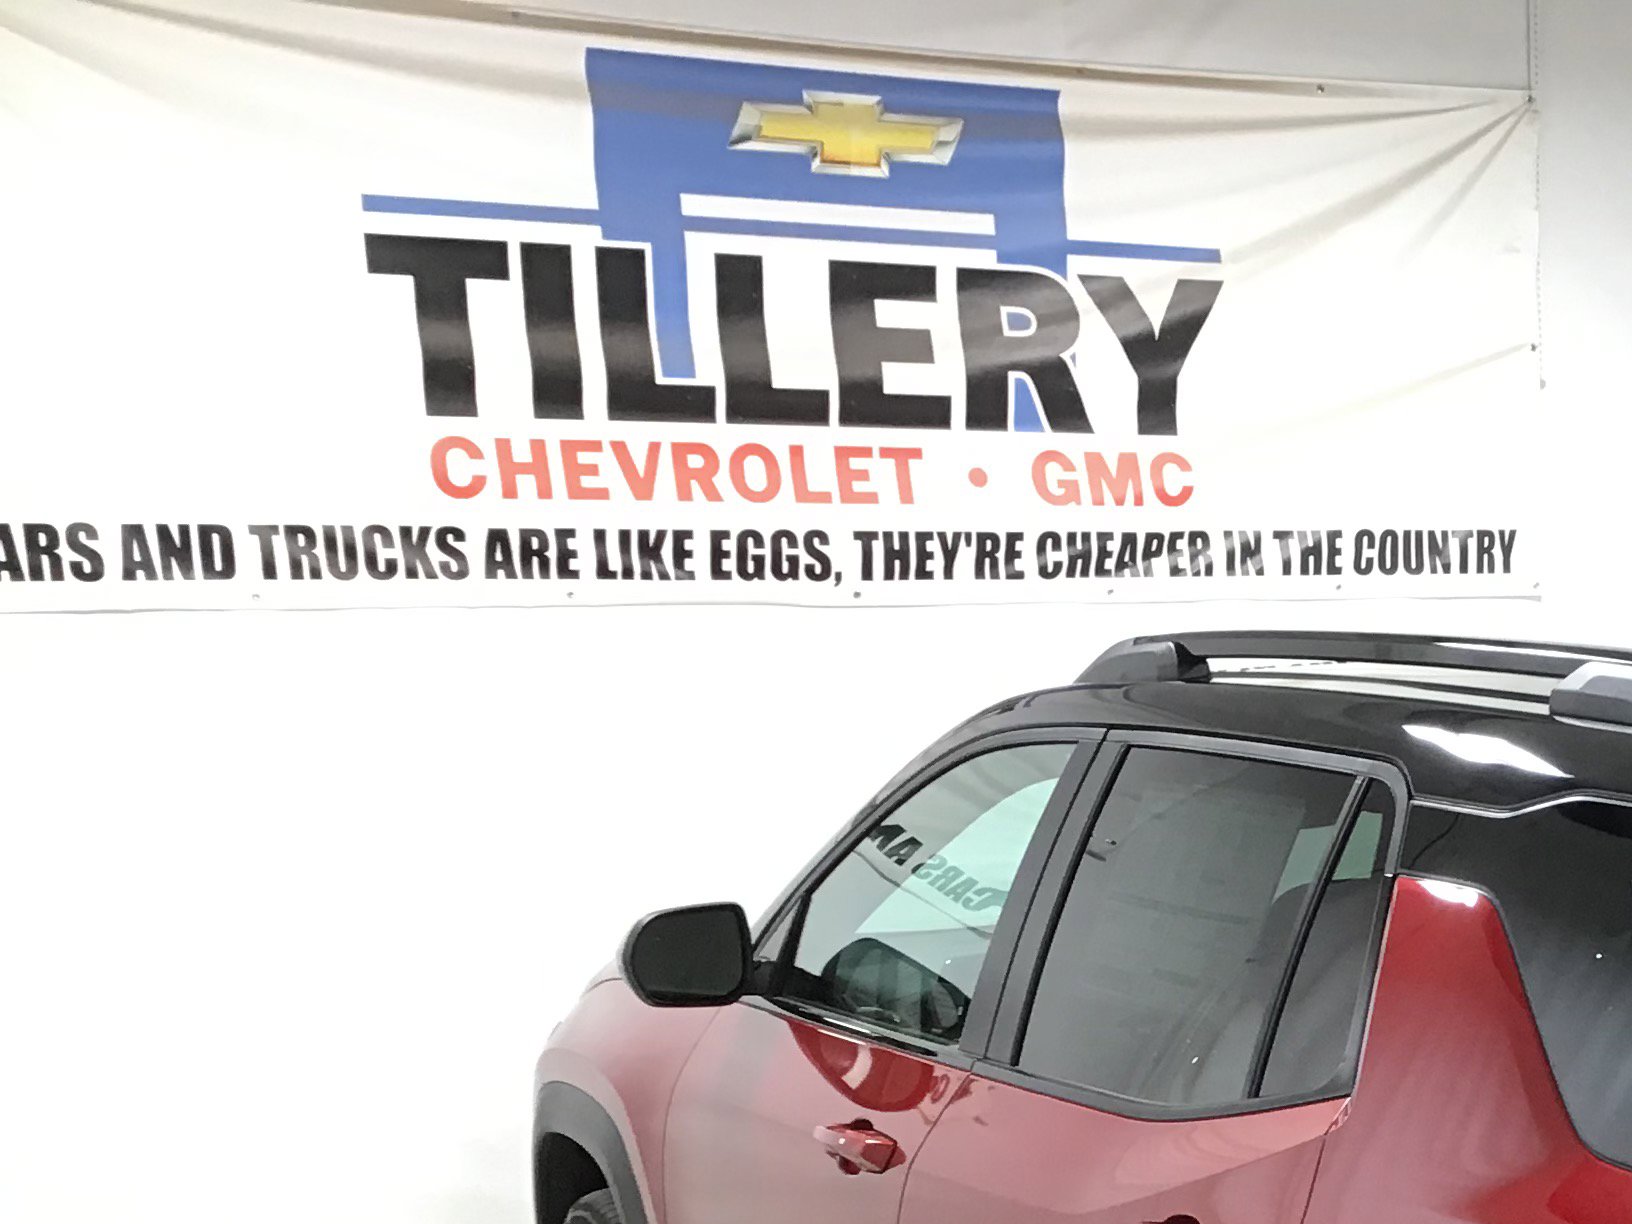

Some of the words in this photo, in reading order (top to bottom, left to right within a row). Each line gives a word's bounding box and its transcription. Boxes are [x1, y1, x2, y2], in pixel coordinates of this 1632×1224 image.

[365, 233, 1223, 436] TILLERY
[430, 436, 923, 504] CHEVROLET
[1031, 450, 1194, 507] GMC
[121, 523, 236, 581] AND
[248, 524, 469, 581] TRUCKS
[485, 528, 580, 580] ARE
[593, 528, 696, 580] LIKE
[710, 529, 842, 588] EGGS,
[853, 530, 1025, 581] THEY'RE
[1036, 530, 1213, 580] CHEAPER
[1223, 530, 1267, 577] IN
[1273, 530, 1344, 575] THE
[1353, 529, 1518, 577] COUNTRY
